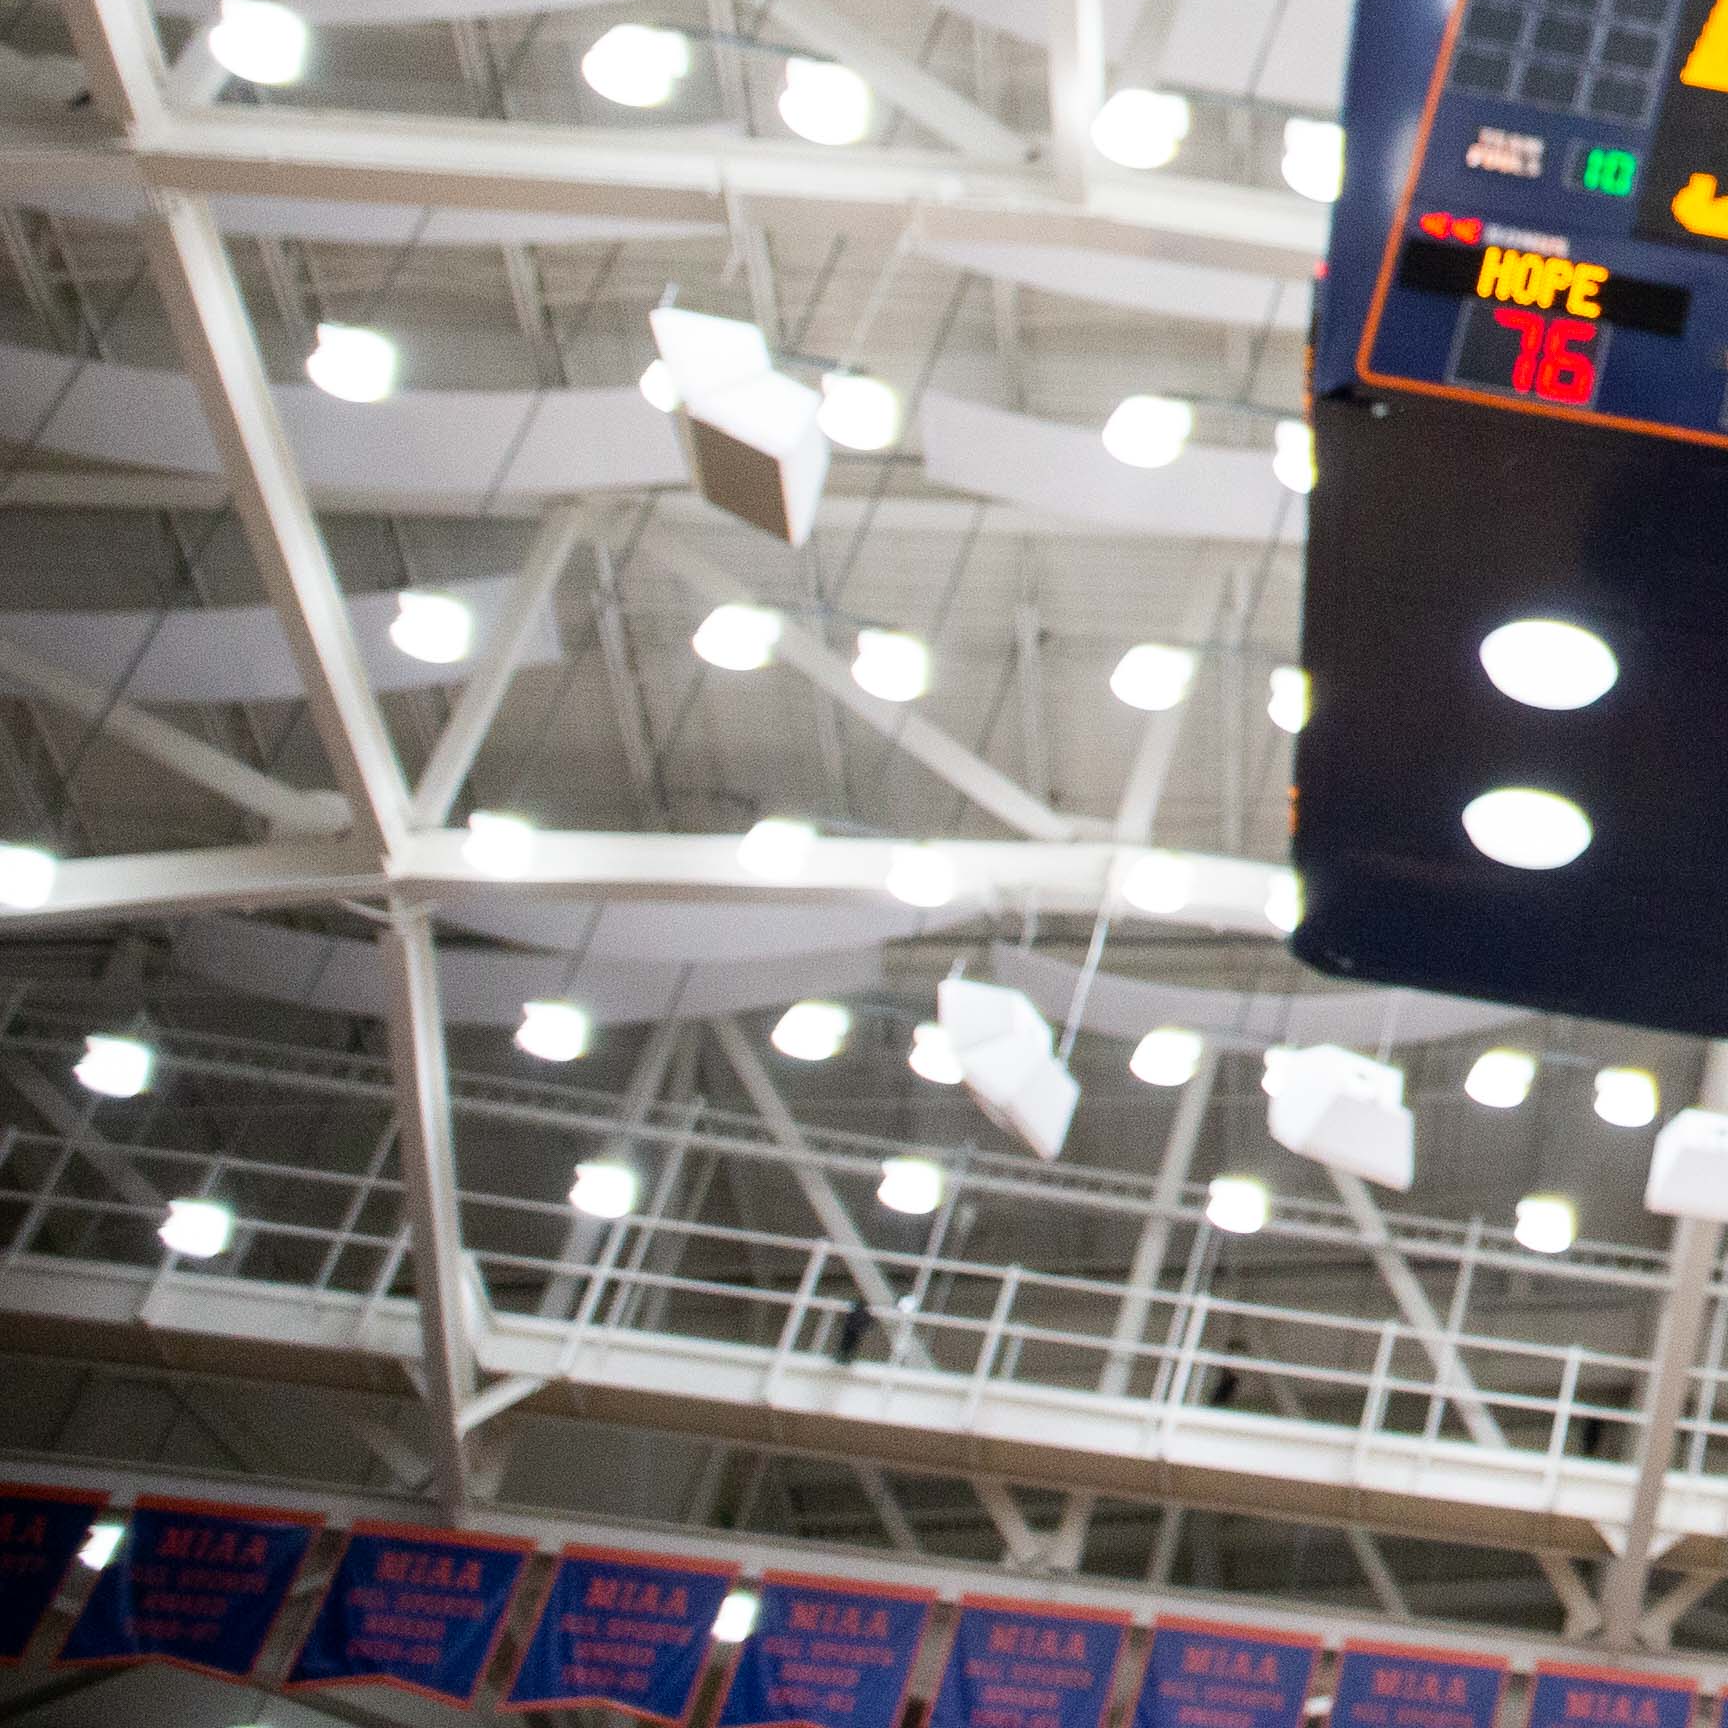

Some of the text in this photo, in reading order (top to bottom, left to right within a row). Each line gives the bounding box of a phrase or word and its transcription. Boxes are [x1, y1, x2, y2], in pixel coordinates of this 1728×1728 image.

[1476, 245, 1609, 319] HOPE
[1493, 307, 1598, 407] 76
[156, 1526, 269, 1566] MIAA
[375, 1551, 484, 1590] MIAA
[585, 1577, 687, 1617] MIAA
[789, 1601, 891, 1638] MIAA
[989, 1625, 1086, 1660] MIAA
[1182, 1646, 1280, 1686] MIAA
[1372, 1669, 1468, 1709] MIAA
